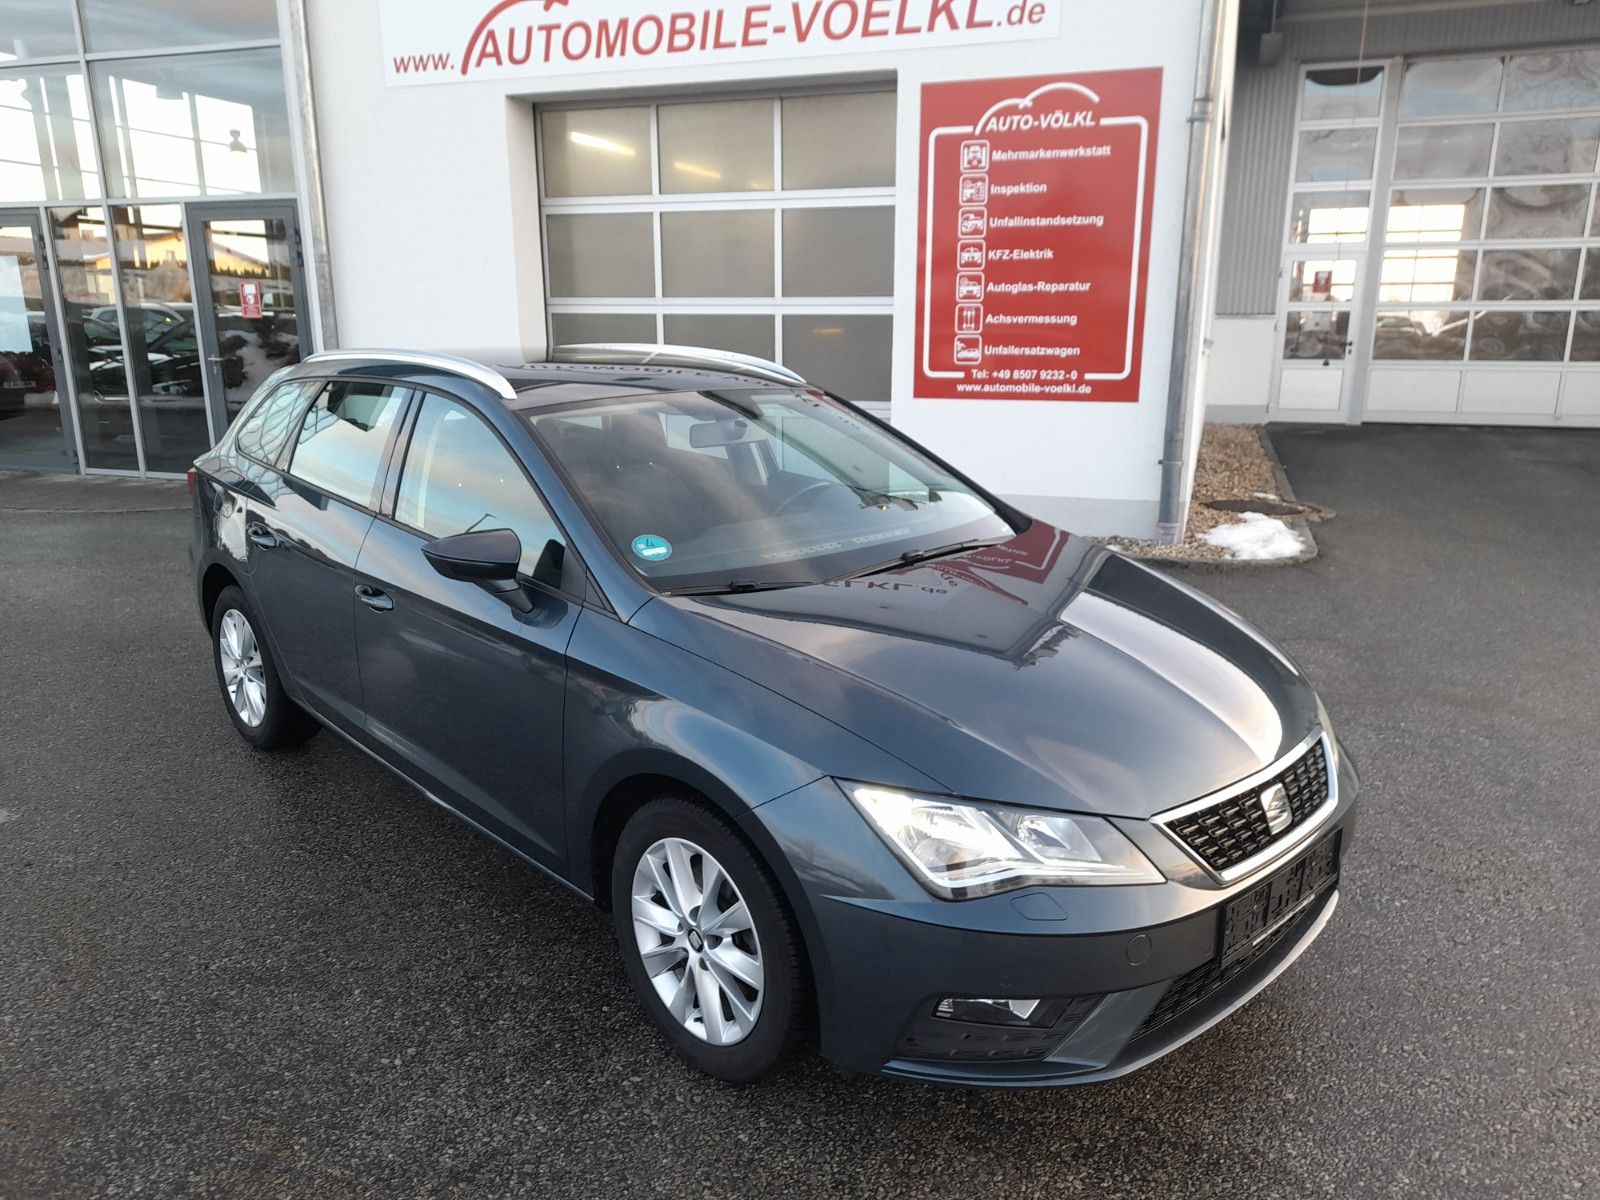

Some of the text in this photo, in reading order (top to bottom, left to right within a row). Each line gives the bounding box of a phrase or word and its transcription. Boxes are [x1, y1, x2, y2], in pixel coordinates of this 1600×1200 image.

[985, 110, 1097, 132] AUTO-VÖLKL
[991, 145, 1112, 161] Mehrmarkenwerkstatt
[990, 183, 1048, 197] Inspektion
[989, 214, 1104, 228] Unfallinstandsetzung
[987, 249, 1054, 261] KFZ-Elektrik
[986, 281, 1092, 294] Autoglas-Reparatur
[985, 313, 1078, 326] Achsvermessung
[984, 345, 1081, 358] Unfallersatzwagen
[971, 369, 990, 379] Tel:
[992, 369, 1011, 379] +49
[1013, 369, 1038, 380] 8507
[956, 382, 1092, 394] www.automobile-voelkl.de
